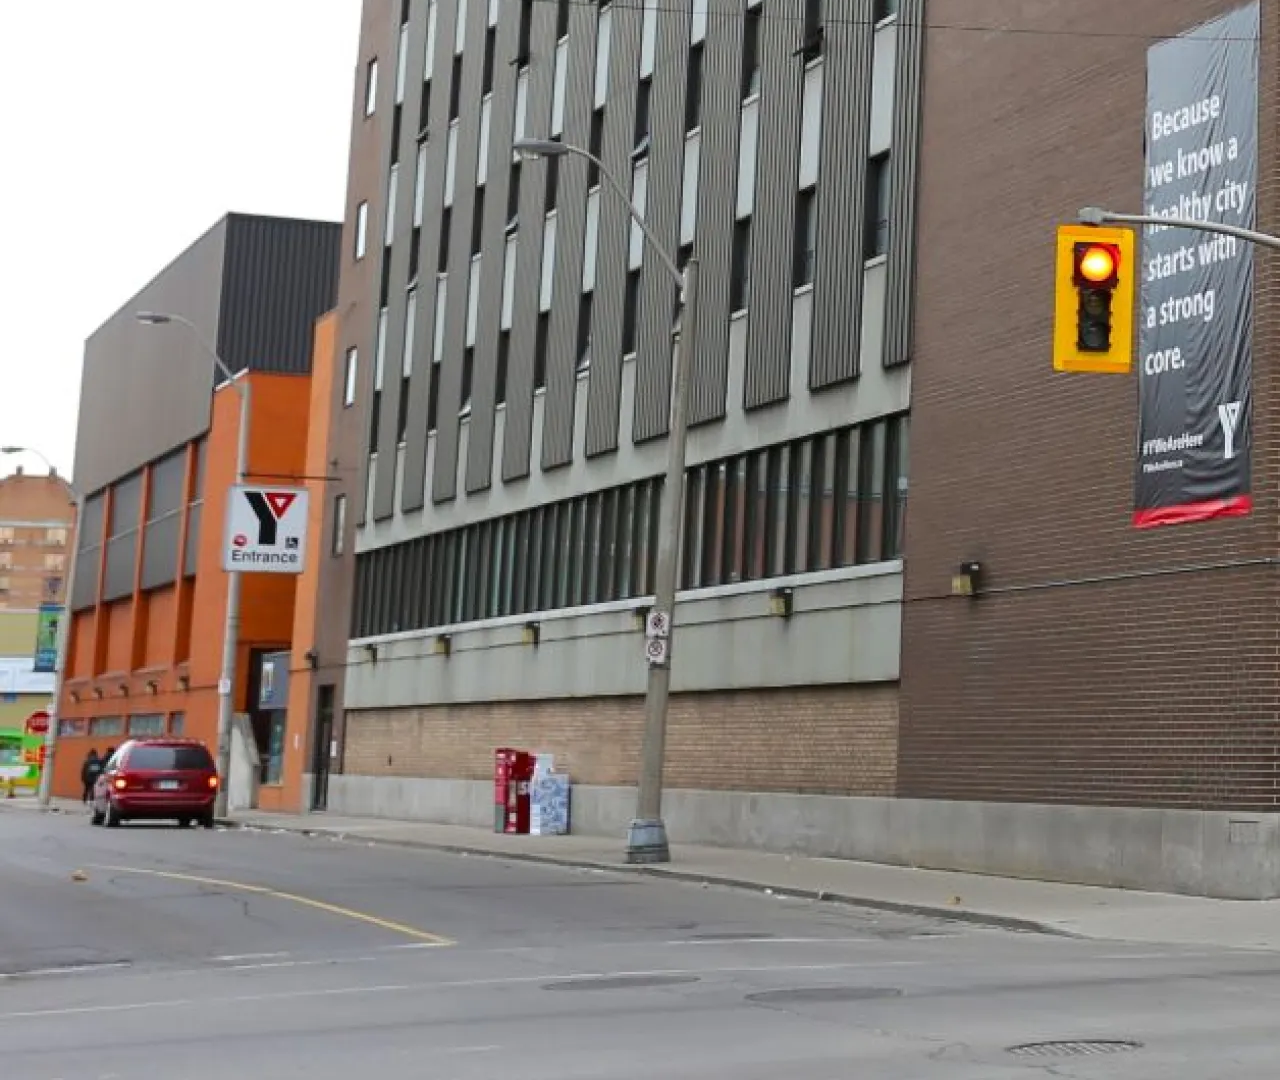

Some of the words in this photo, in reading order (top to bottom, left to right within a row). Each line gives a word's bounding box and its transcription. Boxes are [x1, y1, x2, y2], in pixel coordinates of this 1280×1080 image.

[1151, 94, 1220, 141] Because
[1149, 158, 1173, 188] we
[1177, 140, 1224, 179] know
[1227, 135, 1238, 161] a
[1216, 180, 1248, 215] city
[1147, 245, 1195, 282] starts
[1198, 232, 1236, 266] with
[1147, 305, 1157, 329] a
[1159, 289, 1215, 326] strong
[1145, 346, 1185, 376] core.
[244, 491, 297, 546] Y
[231, 549, 299, 563] Entrance
